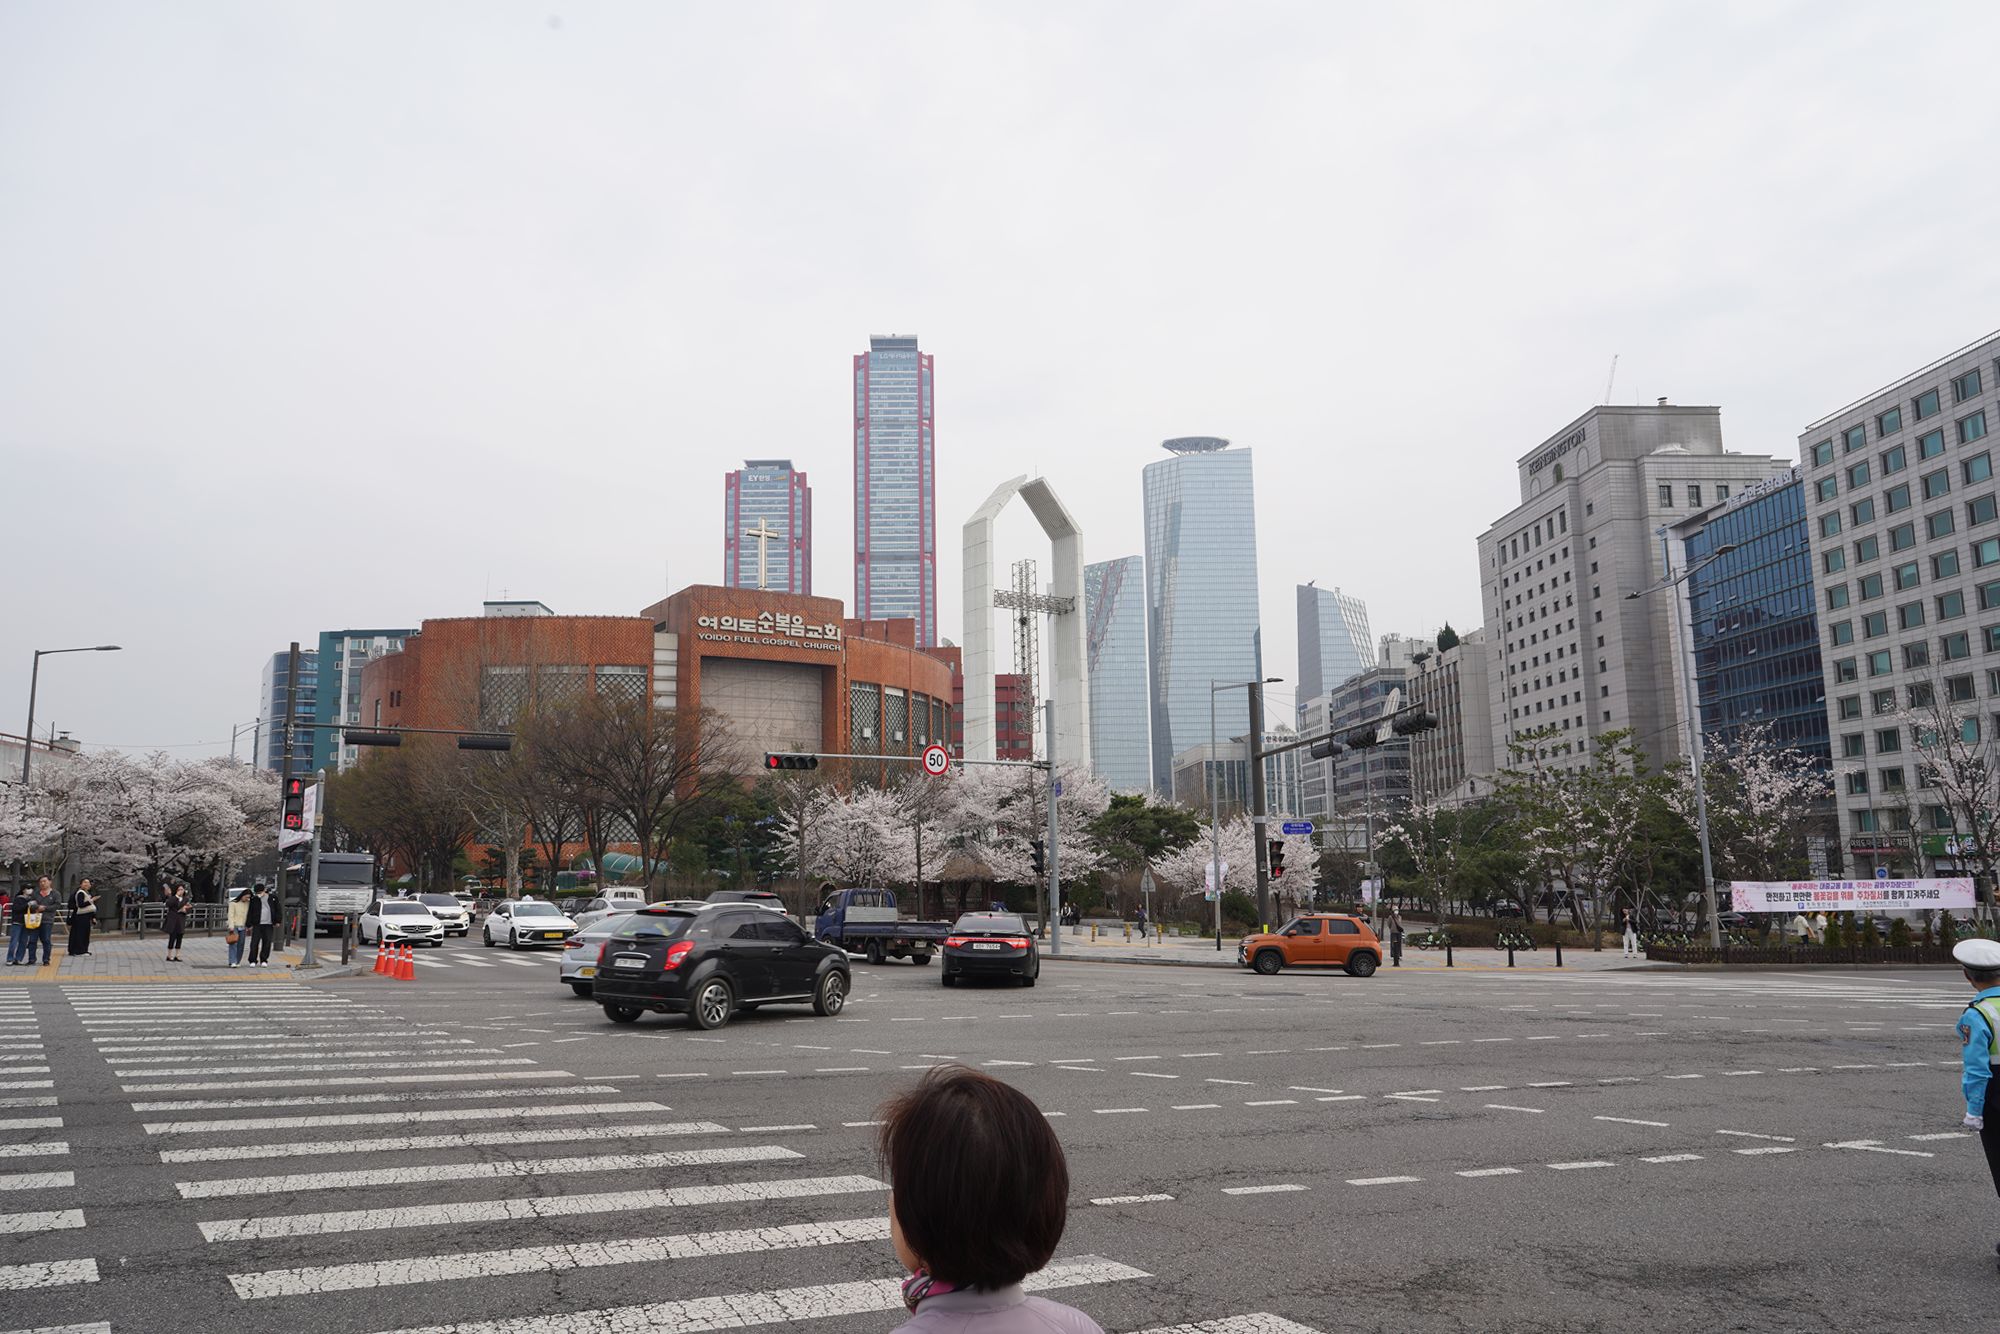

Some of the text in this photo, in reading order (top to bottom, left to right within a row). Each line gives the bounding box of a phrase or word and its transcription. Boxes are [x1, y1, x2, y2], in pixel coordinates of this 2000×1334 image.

[1528, 427, 1586, 477] KENSINGTON
[698, 611, 840, 641] 여의도순복음교회
[698, 632, 841, 651] YOIDO FULL GOSPEL CHURCH
[929, 754, 943, 766] 50
[287, 815, 302, 827] 54
[1766, 889, 1940, 903] 안전하고 편안한 봄꽃길을 위해 주차질서를 함께 지켜주세요
